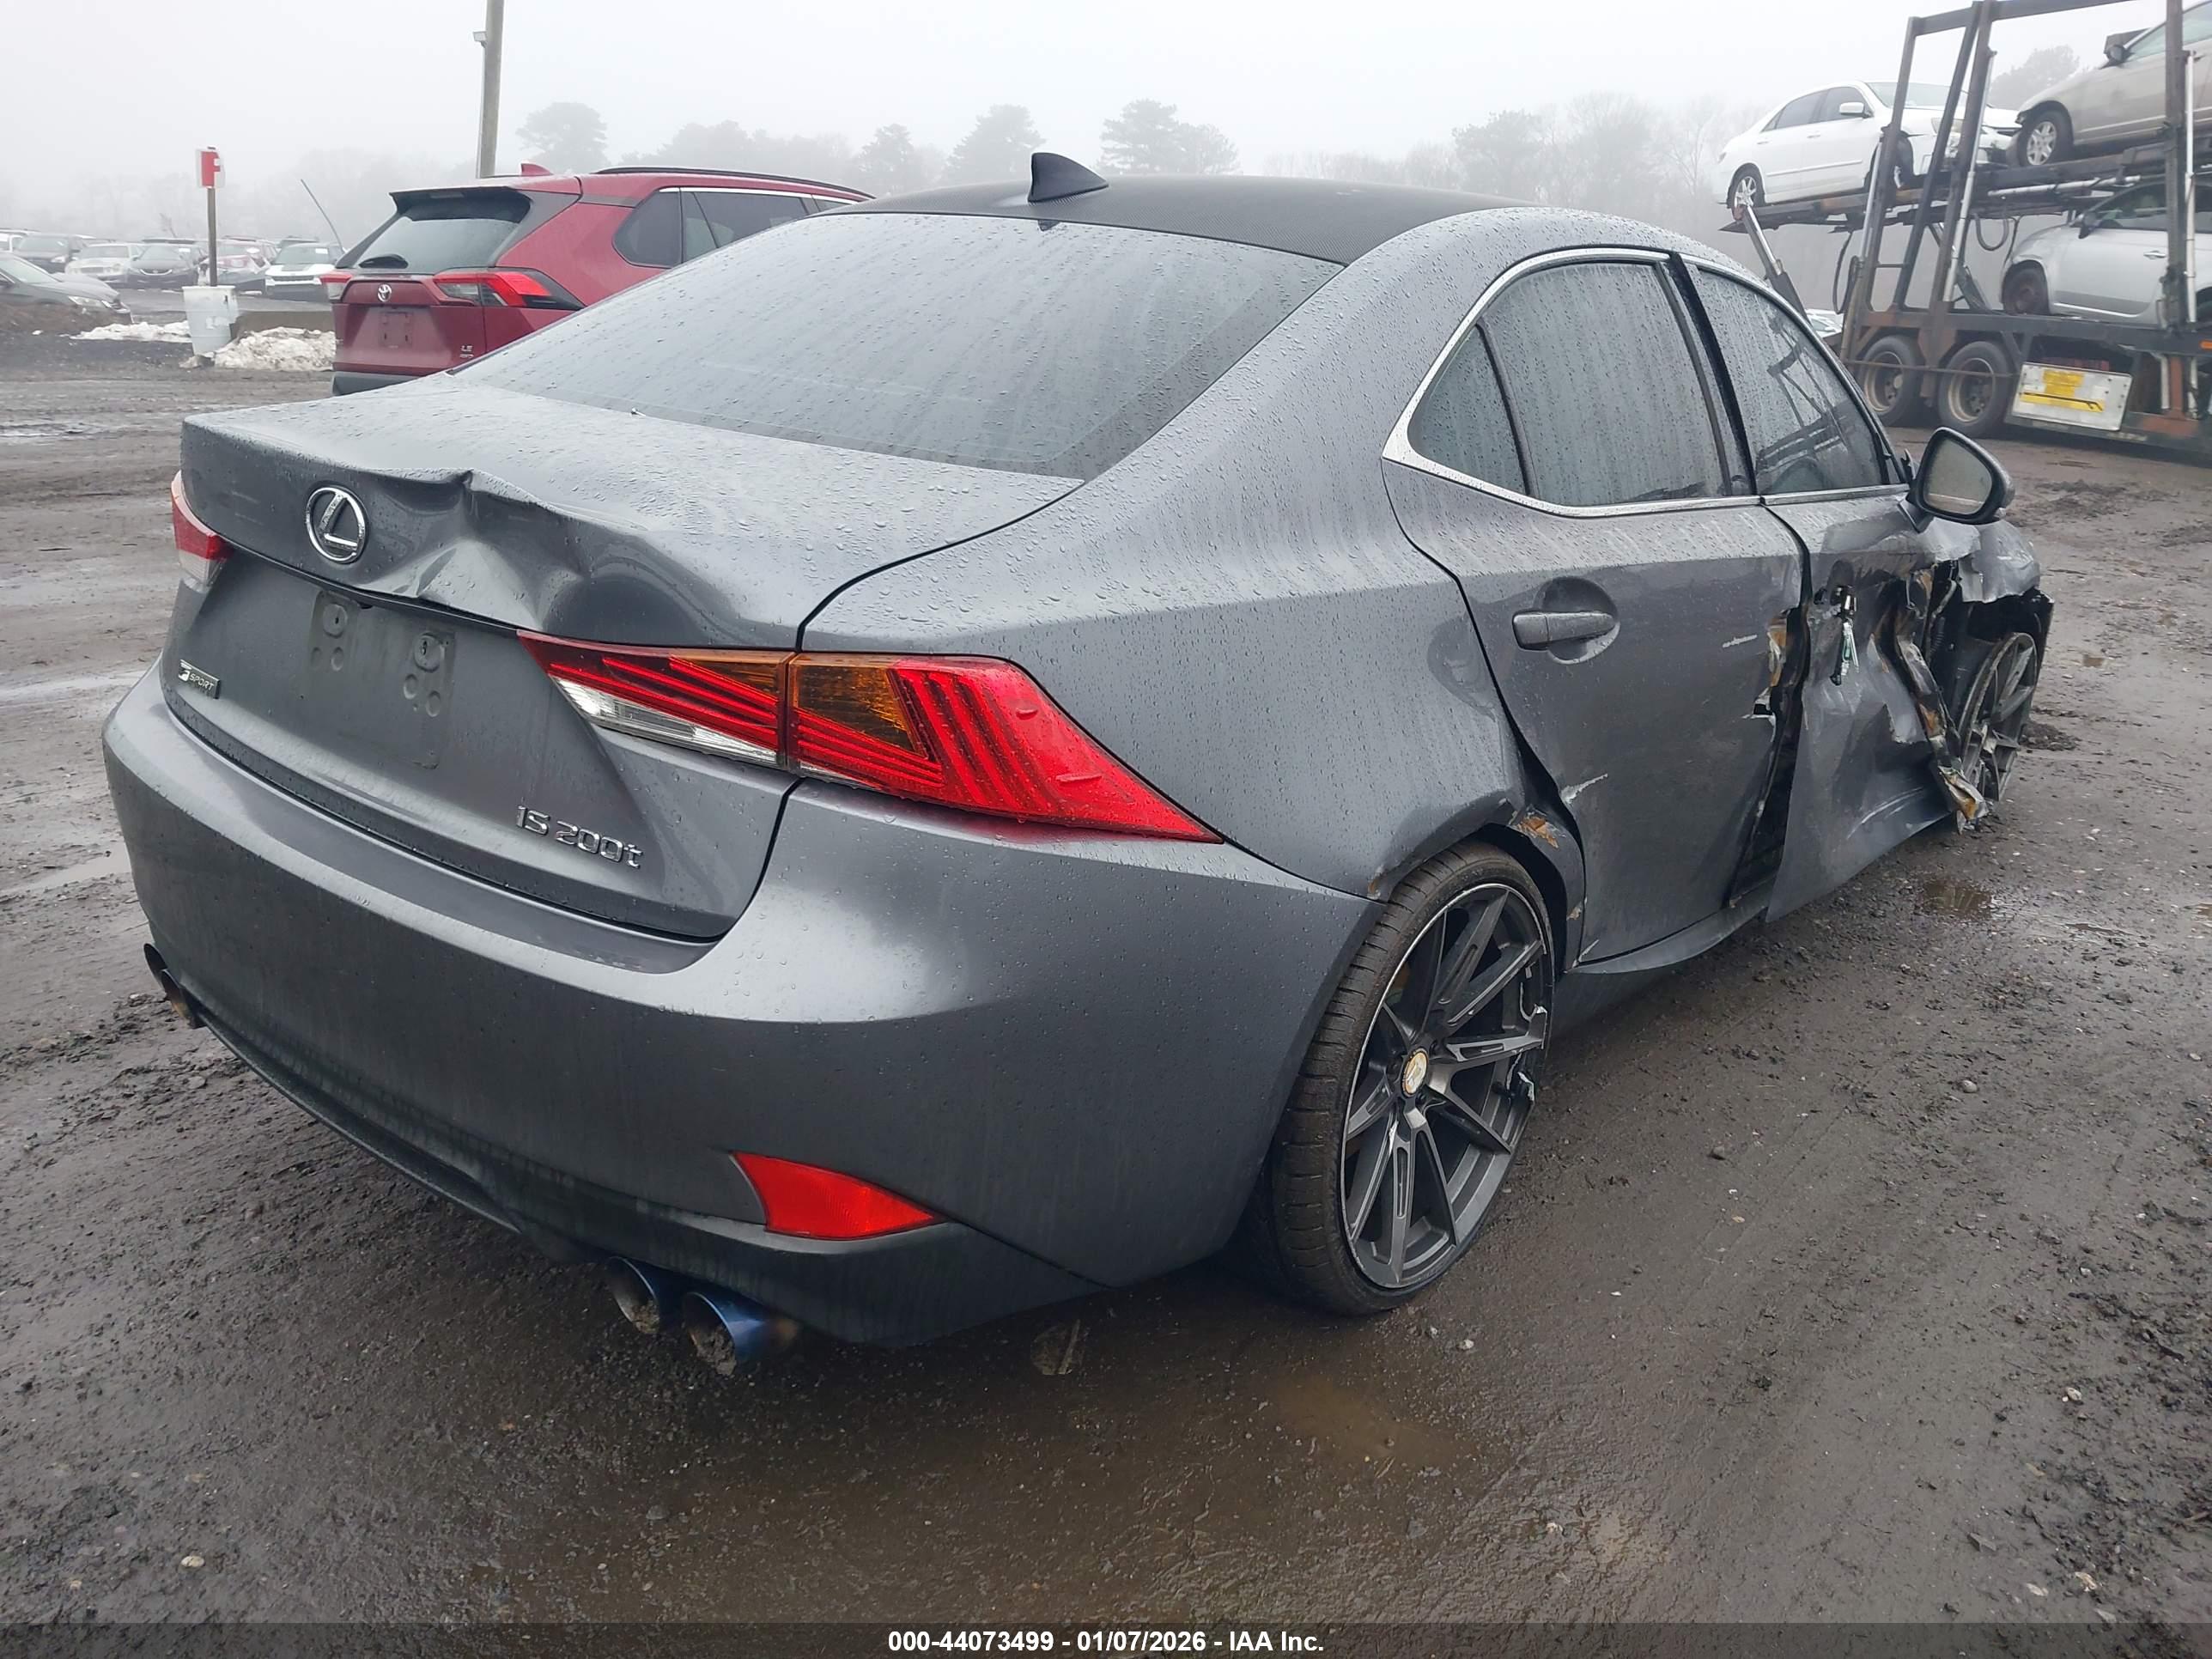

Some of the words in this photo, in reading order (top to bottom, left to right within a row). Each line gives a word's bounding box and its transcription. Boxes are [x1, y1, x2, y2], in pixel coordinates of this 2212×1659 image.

[189, 672, 215, 691] SPORT
[516, 805, 550, 836] IS
[556, 820, 643, 868] 200t
